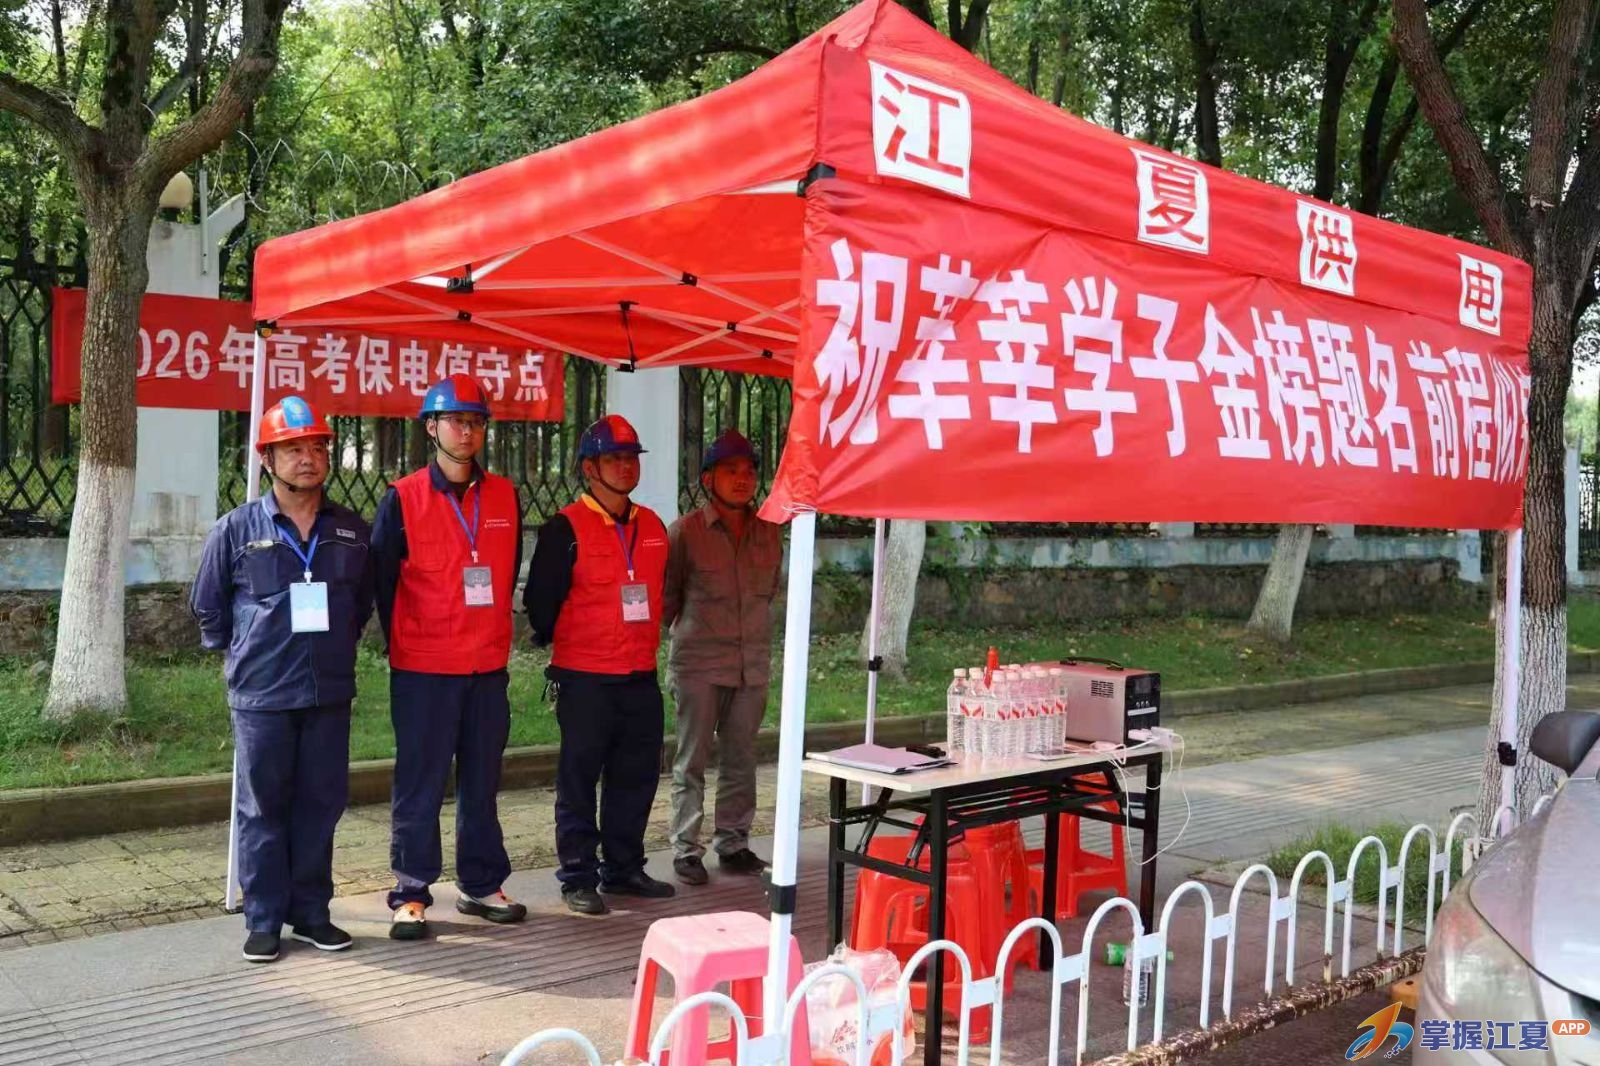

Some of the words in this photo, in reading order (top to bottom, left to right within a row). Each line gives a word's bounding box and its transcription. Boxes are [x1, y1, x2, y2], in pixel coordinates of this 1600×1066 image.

[878, 70, 1498, 328] 江夏供电
[136, 324, 549, 402] 026年高考保电值守点
